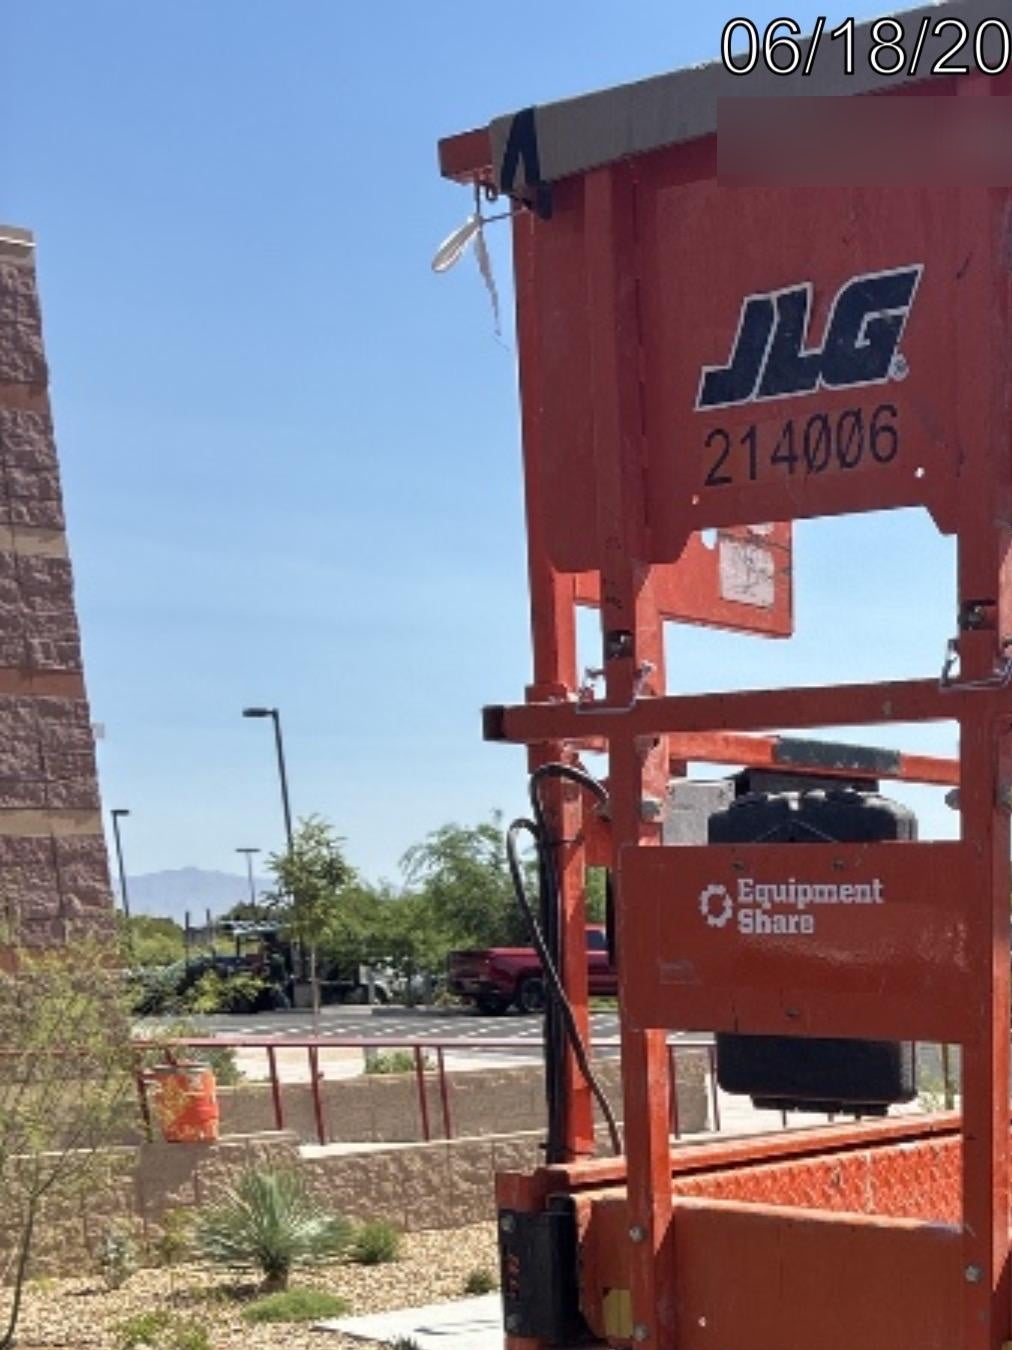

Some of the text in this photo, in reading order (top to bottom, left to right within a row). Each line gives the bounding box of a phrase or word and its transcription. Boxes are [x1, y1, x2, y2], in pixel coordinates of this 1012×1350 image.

[694, 264, 924, 412] JLG
[704, 404, 898, 487] 214006
[737, 878, 884, 910] Equipment
[737, 908, 814, 934] Share
